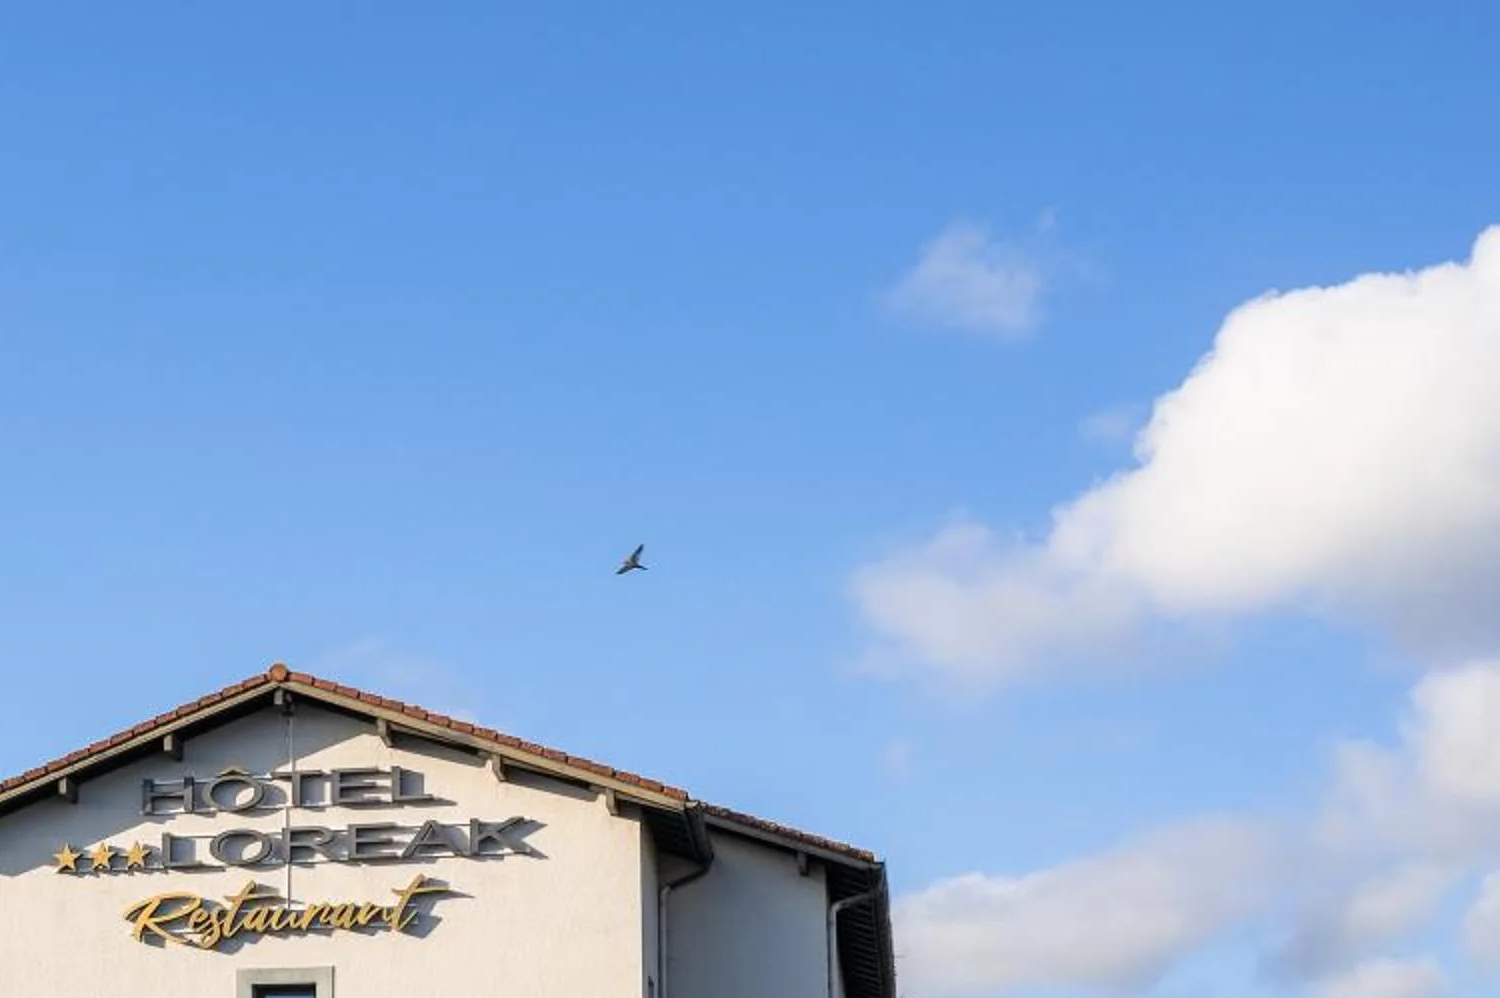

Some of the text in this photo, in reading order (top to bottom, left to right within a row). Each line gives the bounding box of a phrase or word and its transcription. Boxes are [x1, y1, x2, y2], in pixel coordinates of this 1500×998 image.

[142, 765, 438, 814] HÔTEL
[161, 816, 535, 867] LOREAK
[124, 874, 450, 949] Restaurant
